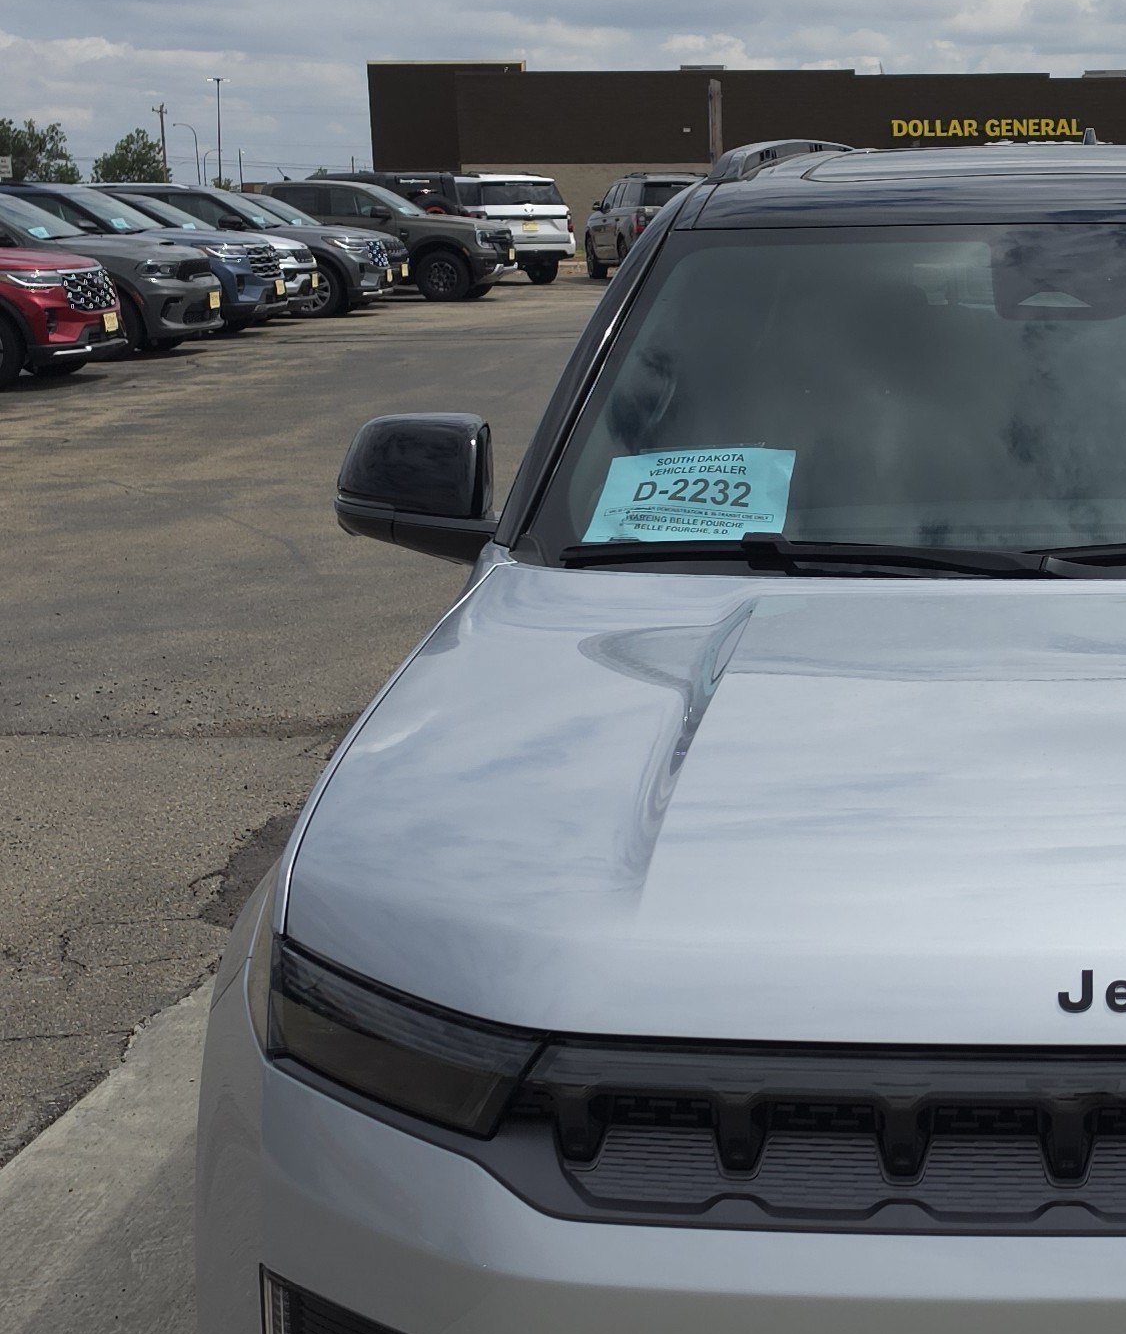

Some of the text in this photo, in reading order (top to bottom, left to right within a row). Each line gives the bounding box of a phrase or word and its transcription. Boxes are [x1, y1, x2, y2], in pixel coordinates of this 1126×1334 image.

[891, 118, 1083, 137] DOLLAR GENERAL
[656, 453, 745, 467] SOUTH DAKOTA
[649, 465, 747, 477] VEHICLE DEALER
[633, 478, 751, 507] D-2232
[634, 523, 663, 531] BELLE
[669, 517, 698, 526] BELLE
[700, 519, 745, 528] FOURCHE
